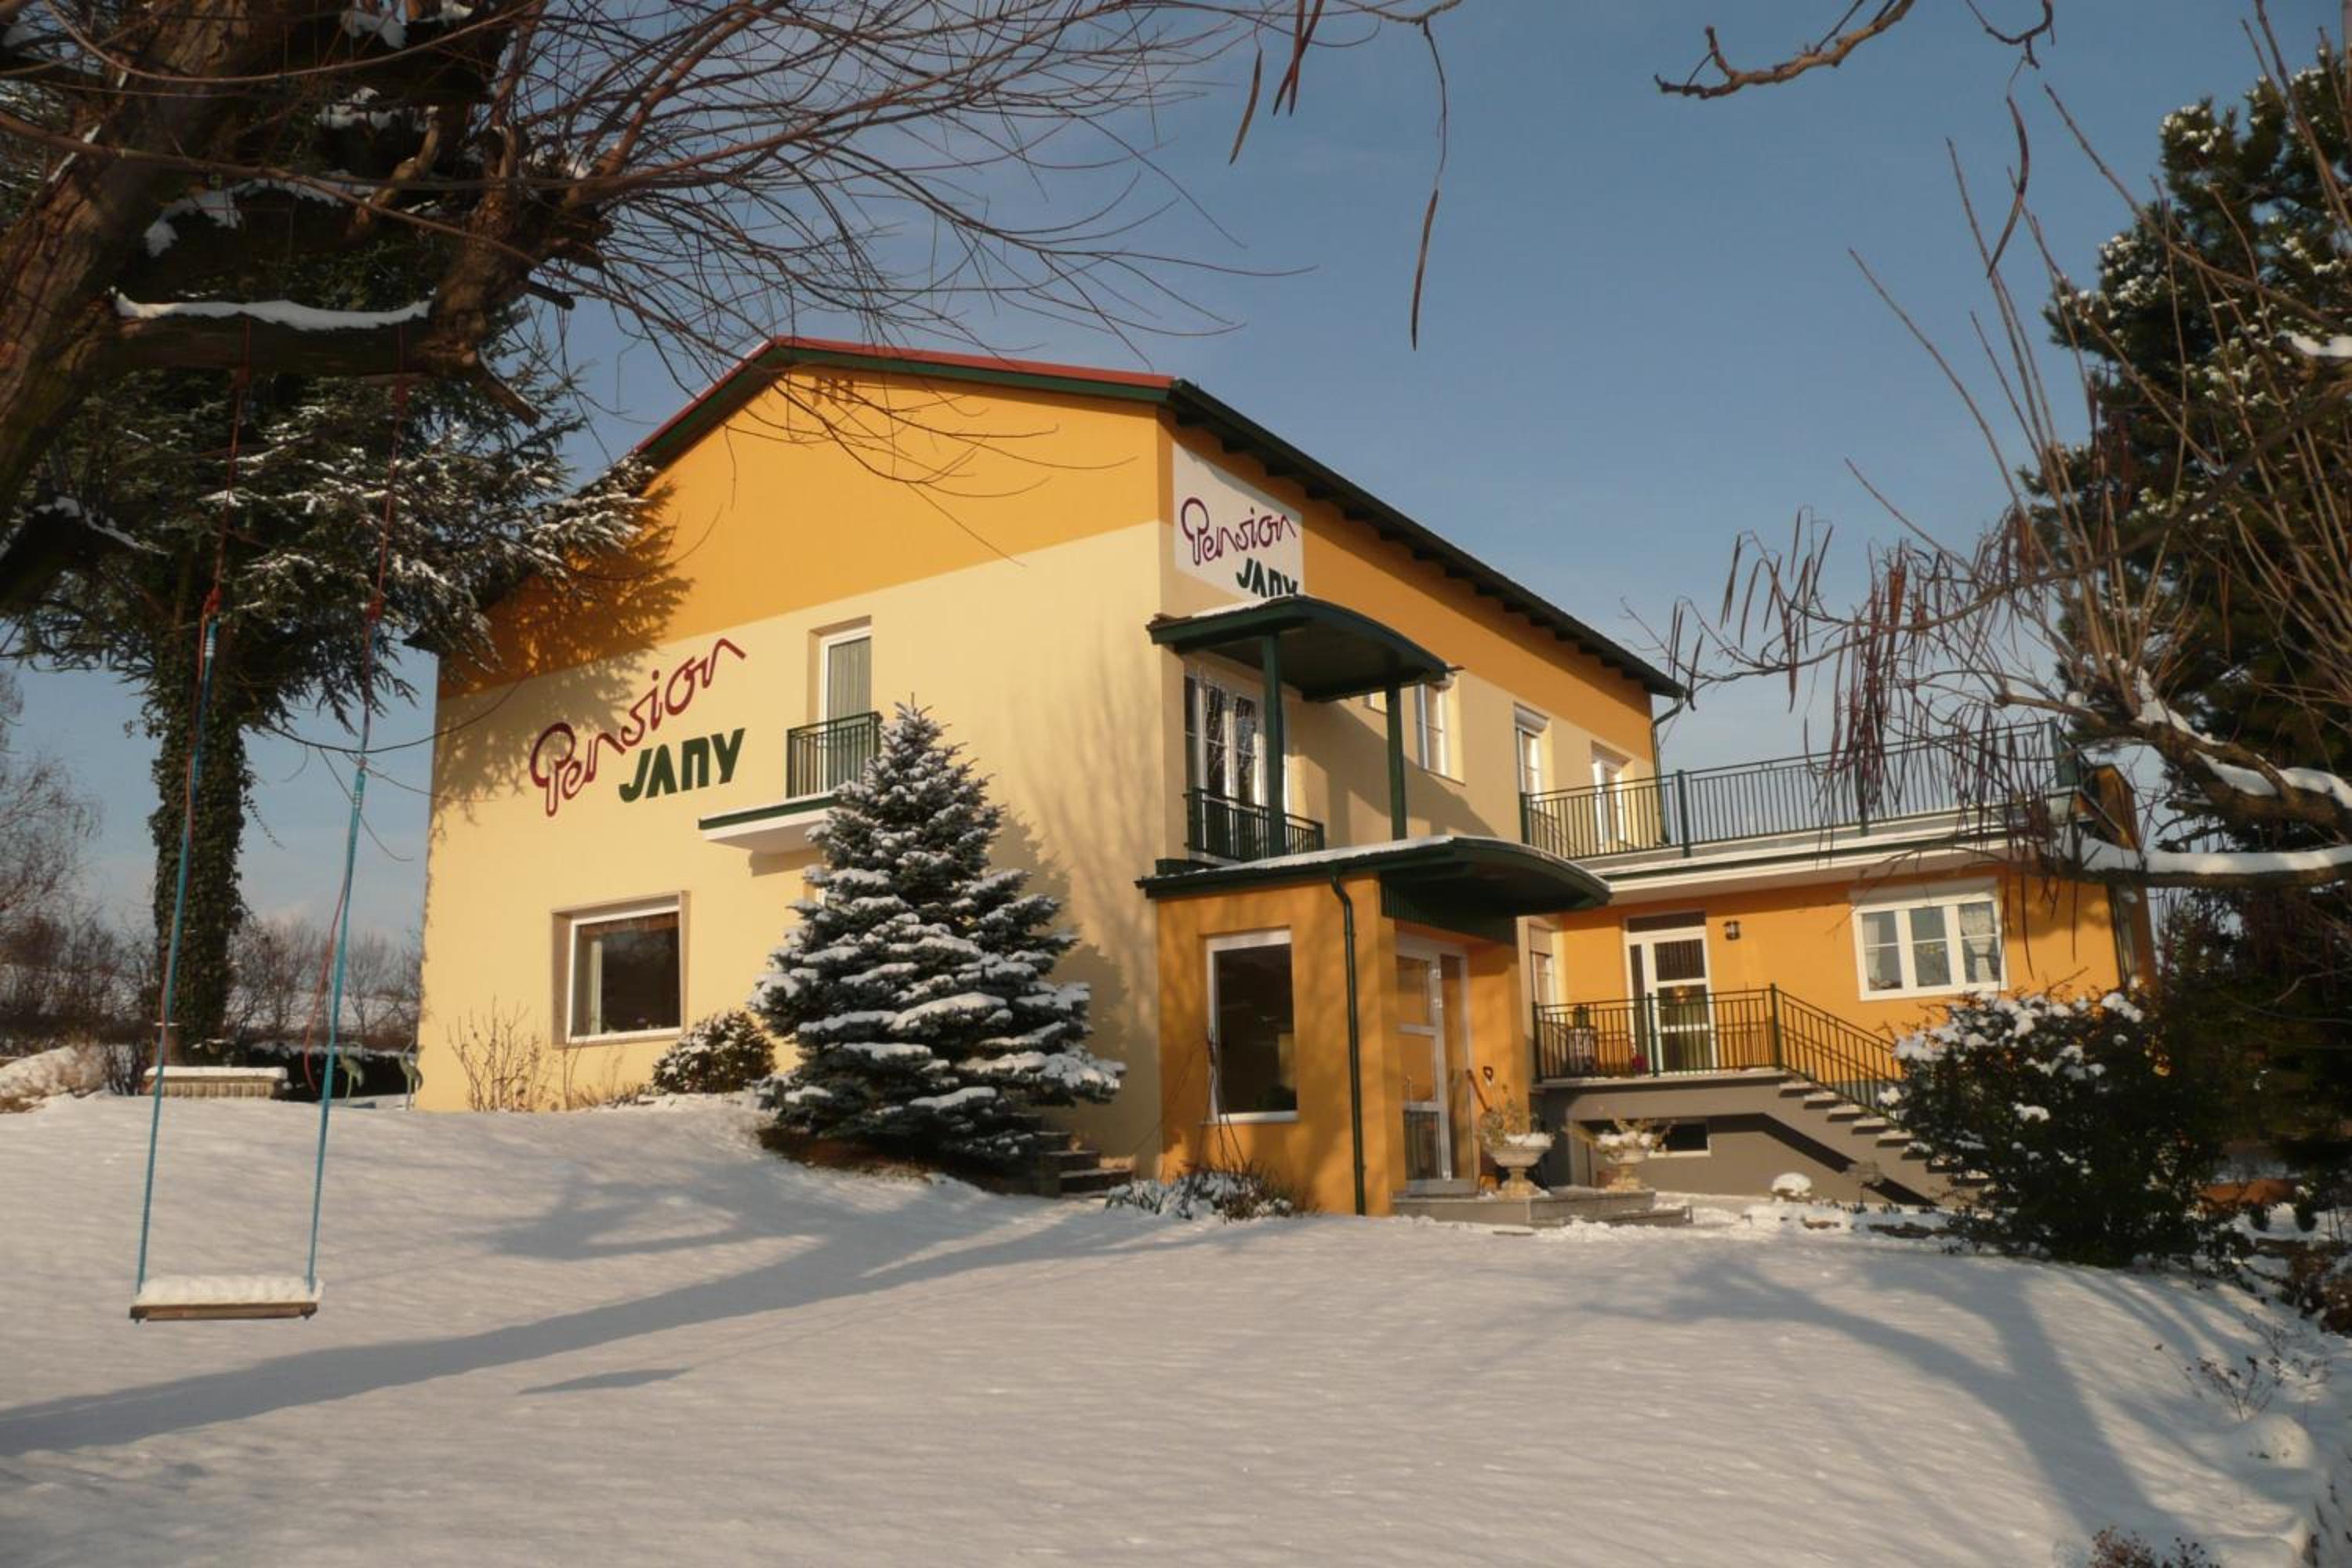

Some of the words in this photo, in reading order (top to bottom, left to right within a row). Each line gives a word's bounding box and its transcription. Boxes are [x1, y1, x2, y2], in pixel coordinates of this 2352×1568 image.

[1180, 497, 1296, 566] Pension
[530, 638, 746, 817] Pension
[619, 728, 746, 803] JANY
